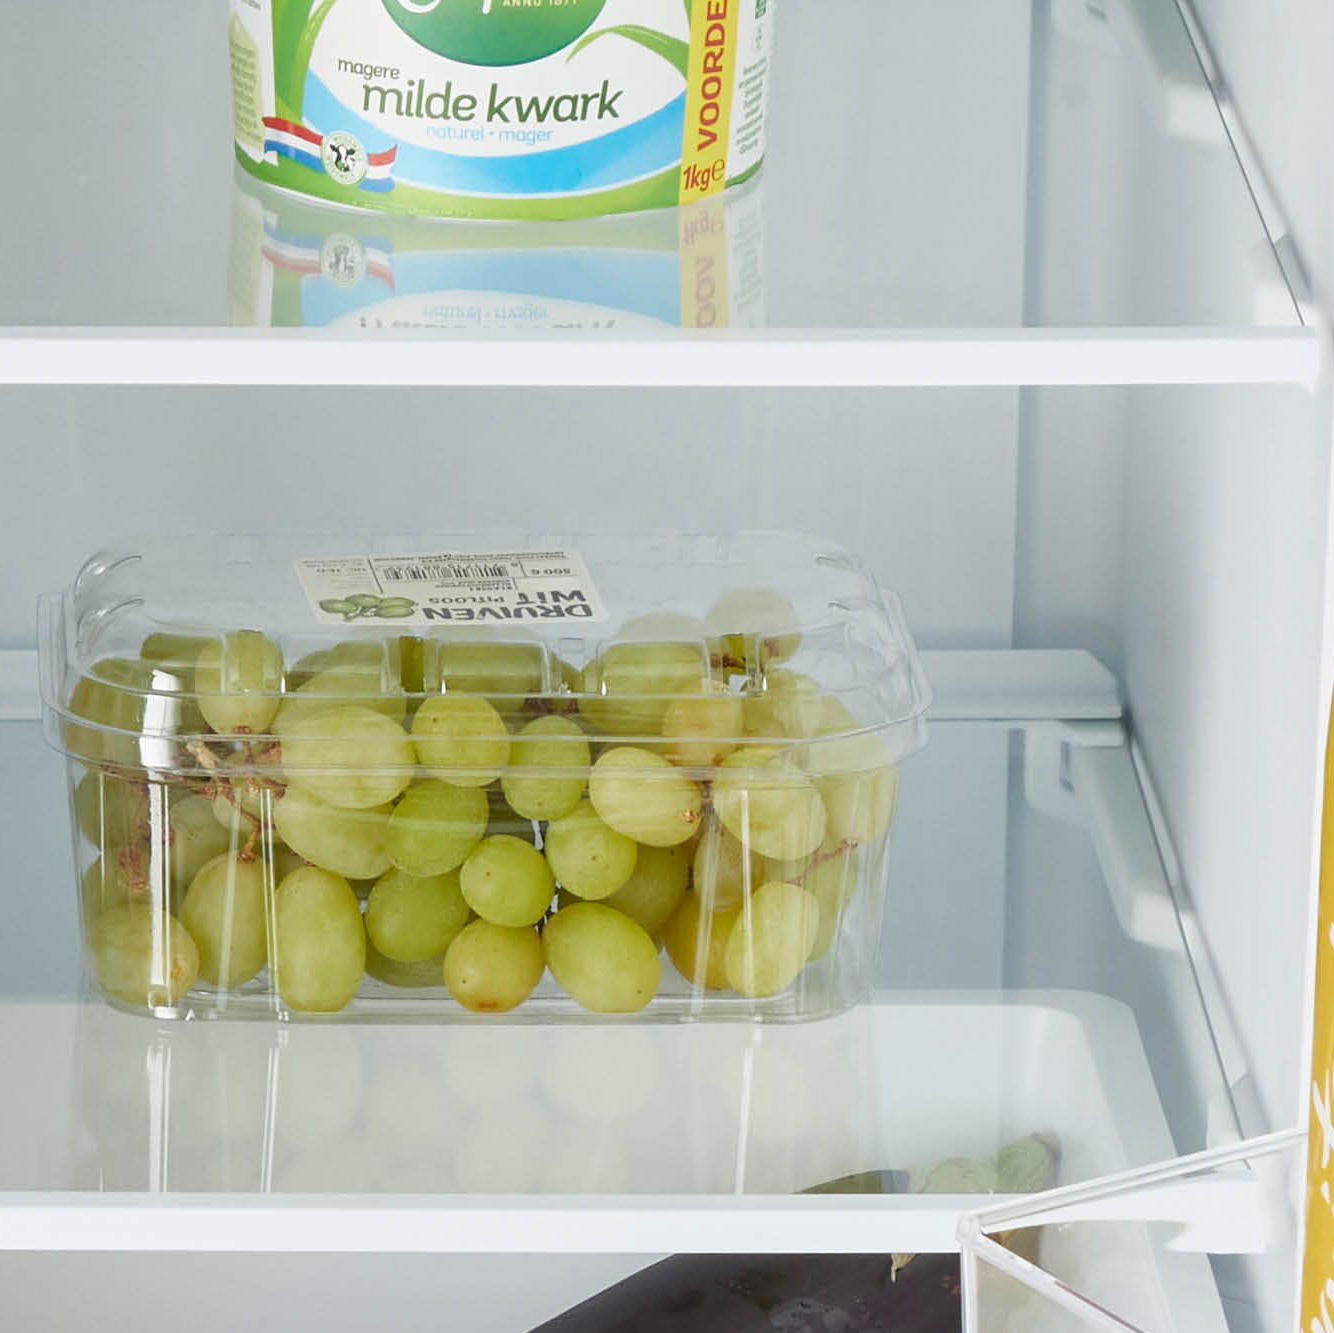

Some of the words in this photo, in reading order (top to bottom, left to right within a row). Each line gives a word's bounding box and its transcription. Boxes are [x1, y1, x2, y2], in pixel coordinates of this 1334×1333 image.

[338, 59, 400, 80] magere
[362, 79, 477, 122] milde
[486, 79, 624, 123] kwark
[426, 125, 484, 142] naturel
[499, 127, 553, 145] mager
[422, 603, 594, 621] DRUIVEN
